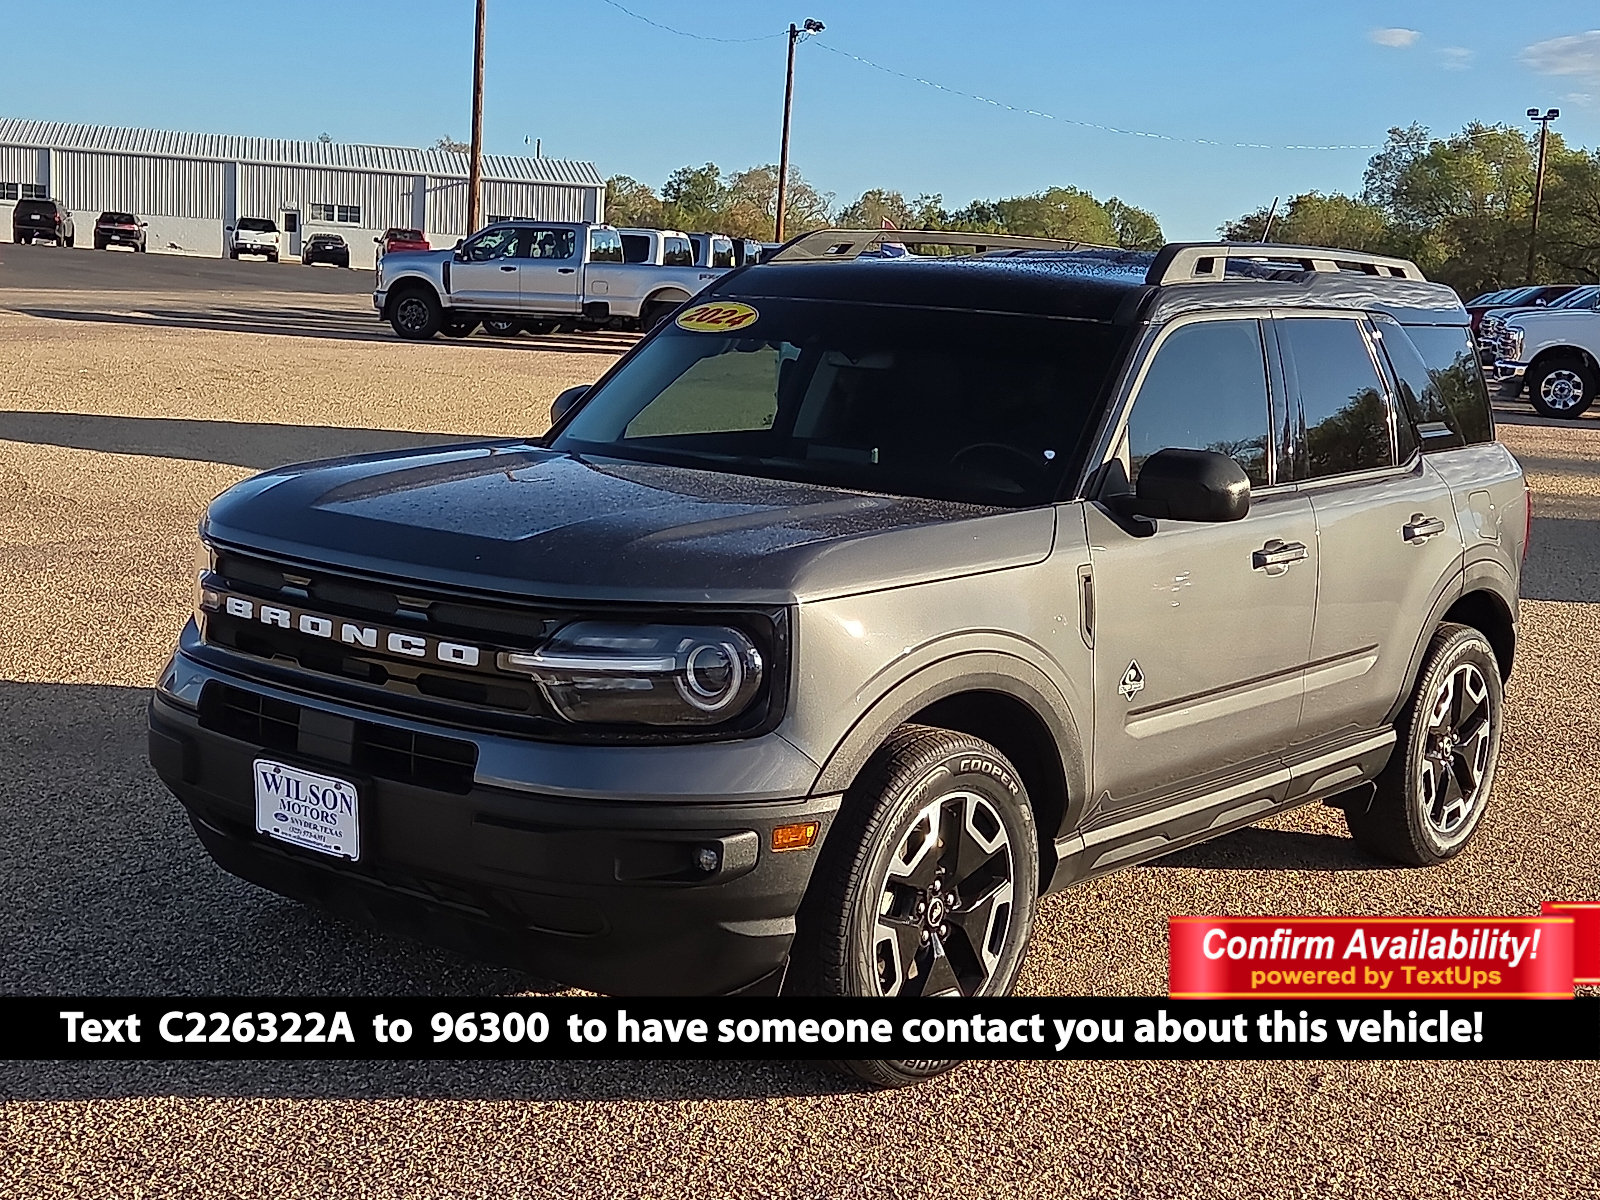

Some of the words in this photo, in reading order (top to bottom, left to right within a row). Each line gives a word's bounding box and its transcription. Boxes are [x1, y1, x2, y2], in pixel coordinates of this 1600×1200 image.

[680, 306, 755, 328] 2024
[225, 596, 480, 667] BRONCO
[260, 770, 354, 817] WILSON
[959, 758, 1020, 797] COOPER
[278, 798, 338, 826] MOTORS
[320, 825, 343, 838] TEXAS
